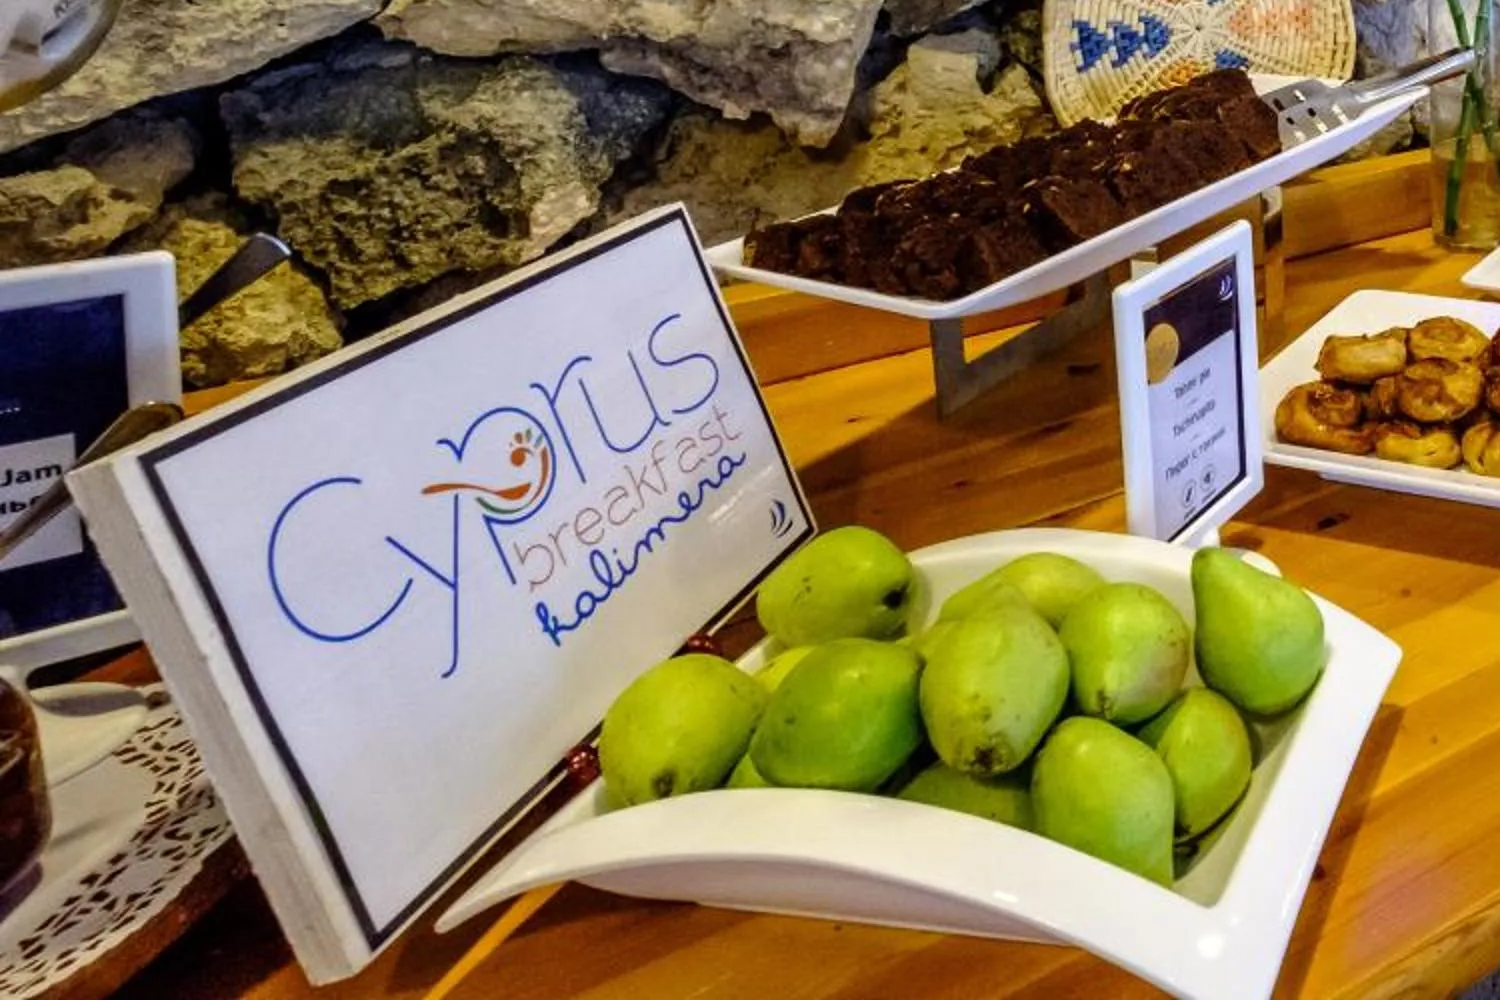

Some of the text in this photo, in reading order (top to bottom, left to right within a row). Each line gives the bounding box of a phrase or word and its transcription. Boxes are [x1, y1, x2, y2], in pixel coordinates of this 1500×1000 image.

[0, 463, 63, 487] Jam
[268, 314, 719, 677] Cyprus
[514, 406, 743, 591] breakfast
[535, 452, 746, 646] kalimera
